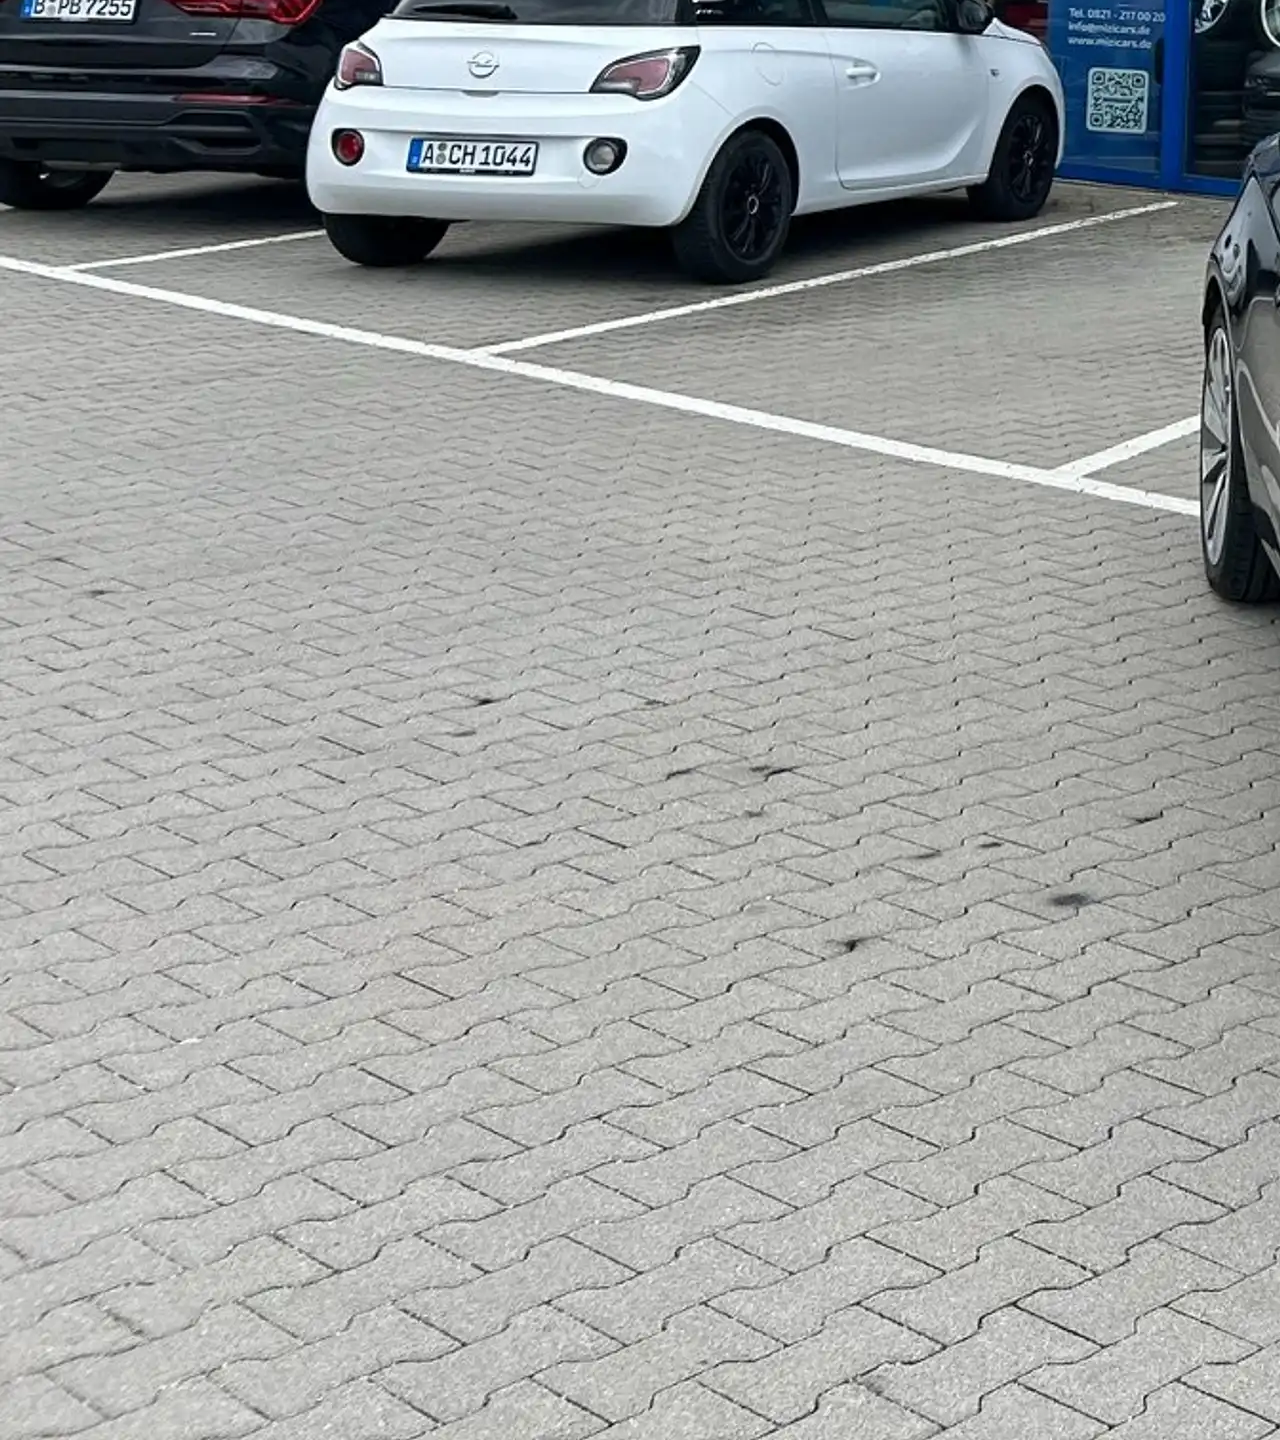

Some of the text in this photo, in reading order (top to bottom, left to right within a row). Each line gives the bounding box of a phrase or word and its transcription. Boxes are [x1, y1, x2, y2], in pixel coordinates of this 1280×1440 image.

[422, 143, 533, 167] A CH 1044
